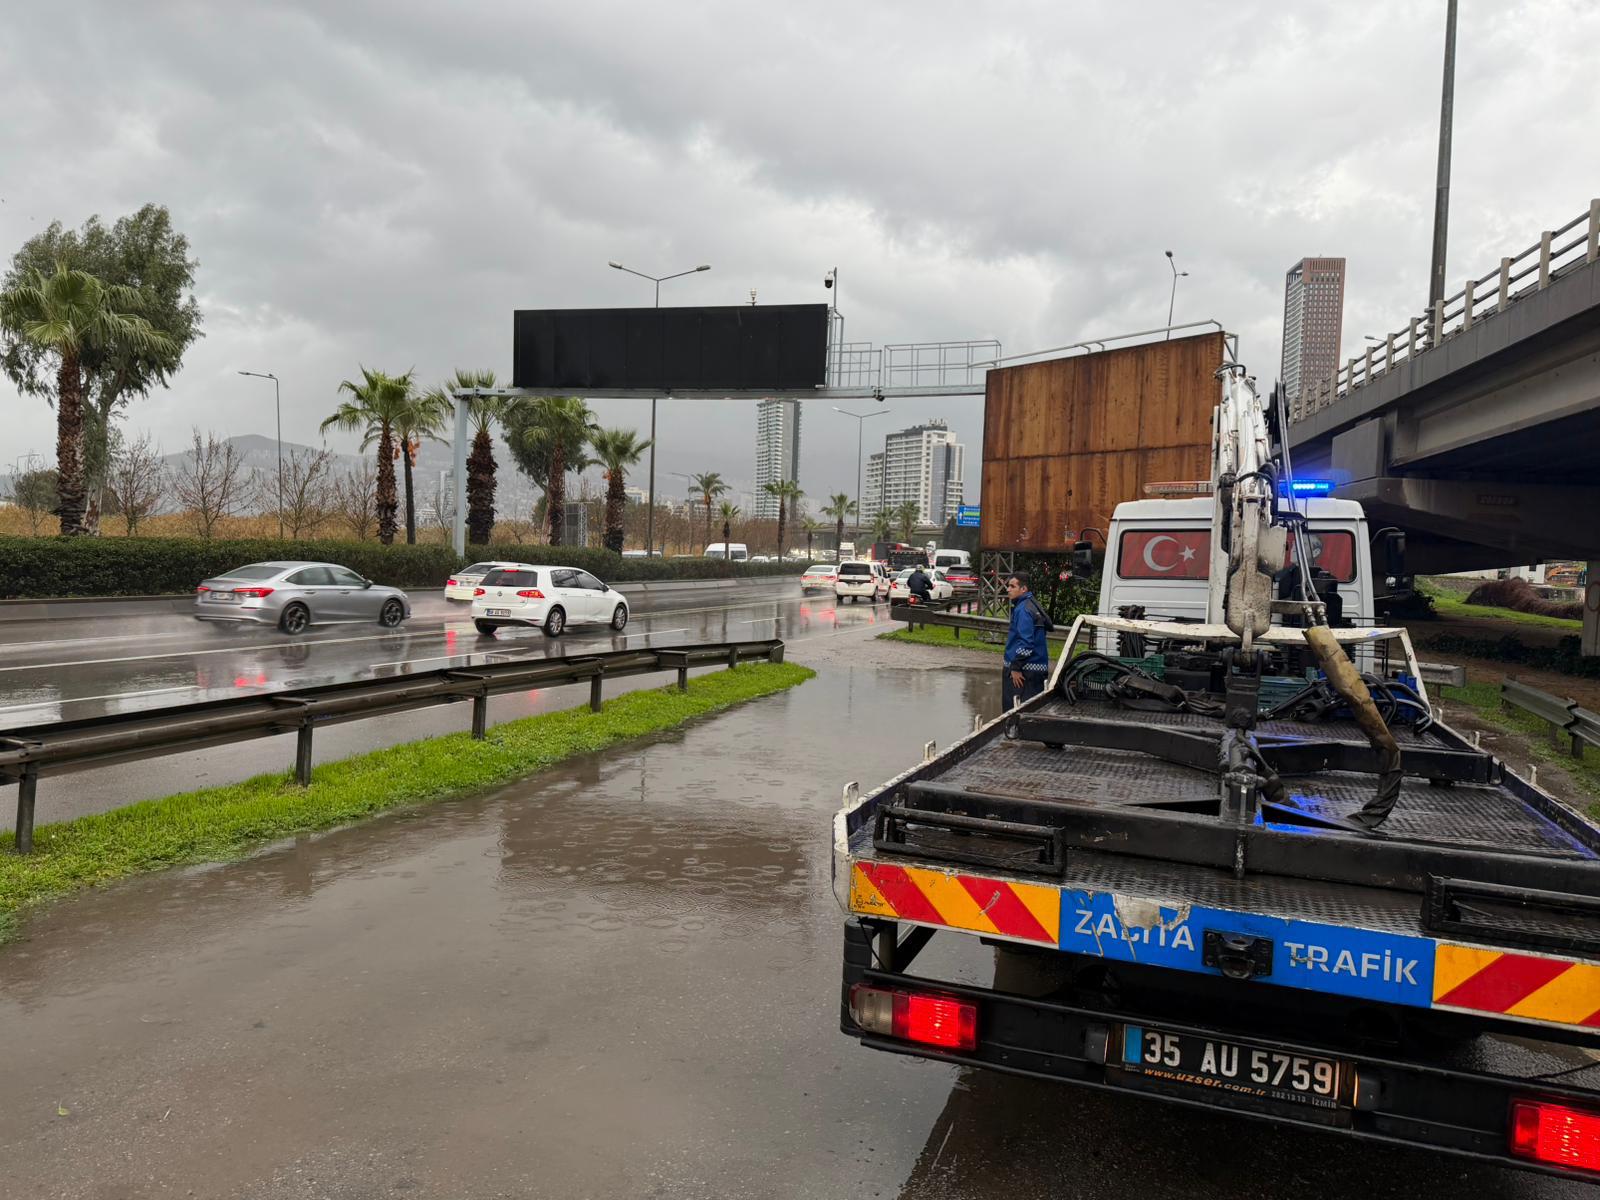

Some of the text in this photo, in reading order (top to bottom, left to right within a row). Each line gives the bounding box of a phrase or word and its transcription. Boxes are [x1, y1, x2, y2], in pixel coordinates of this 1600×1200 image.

[1283, 940, 1419, 986] TRAFİK
[1144, 1032, 1332, 1095] 35 AU 5759
[1144, 1067, 1266, 1096] www.uzser.com.tr
